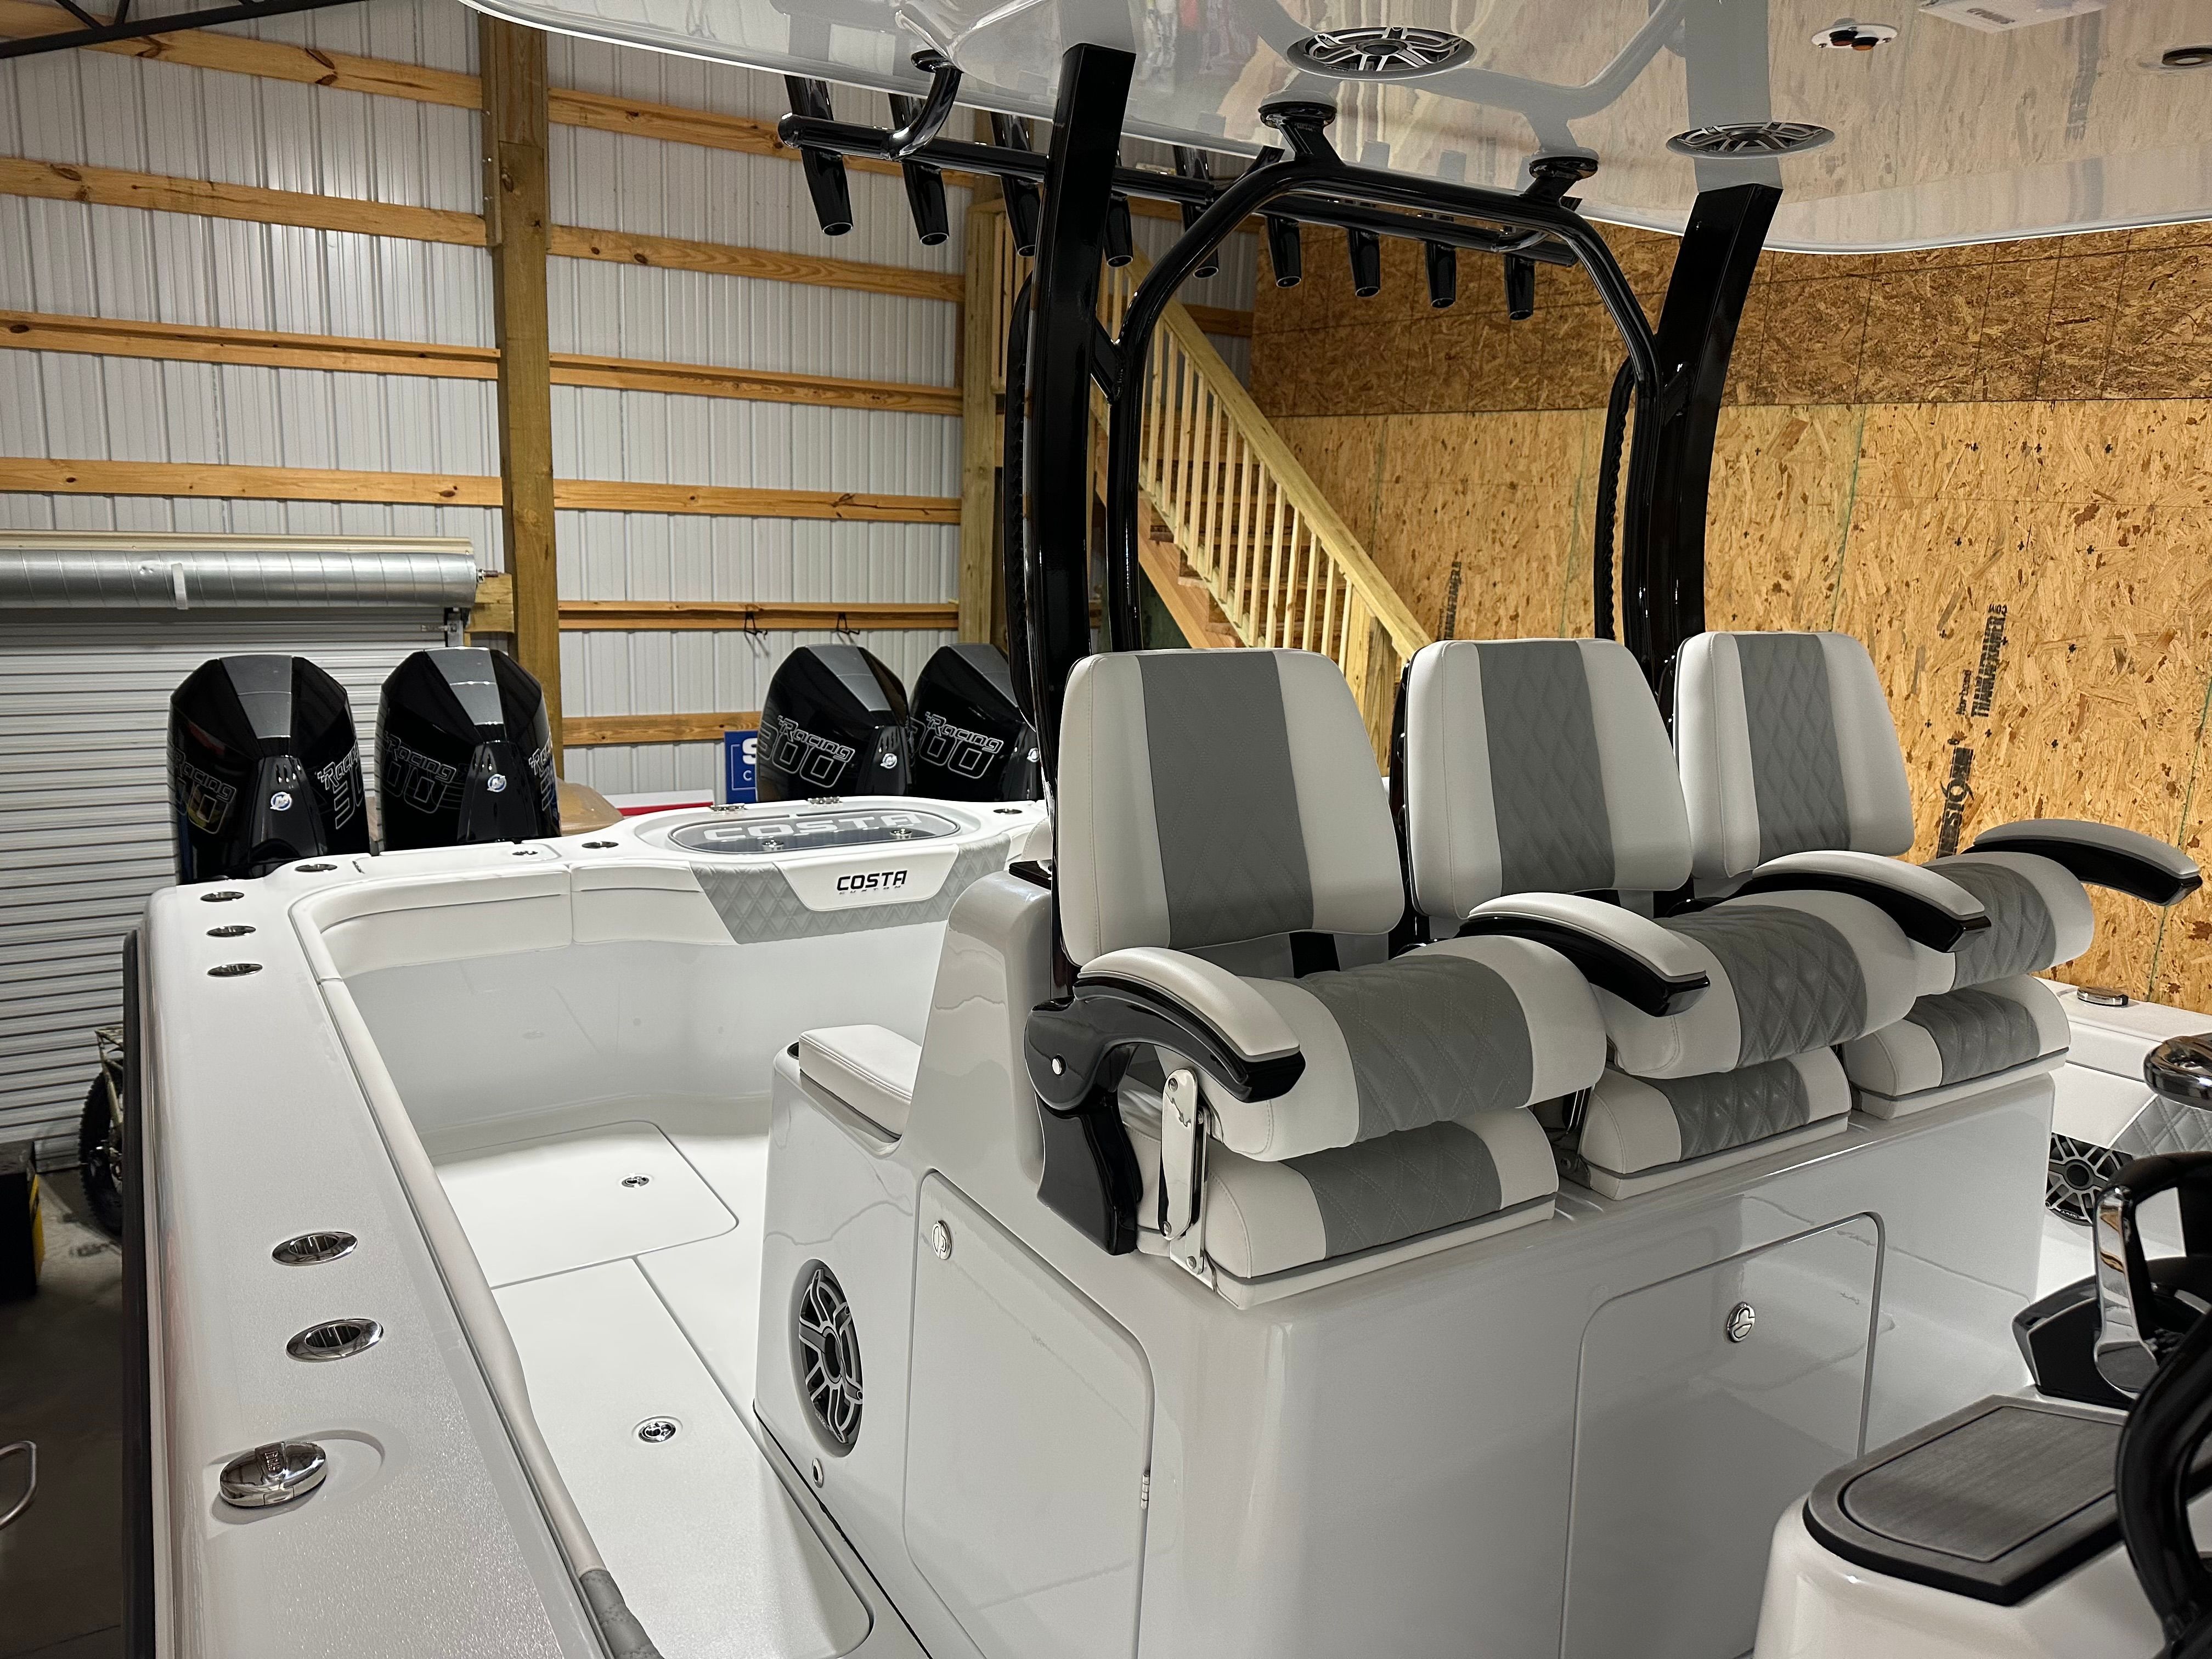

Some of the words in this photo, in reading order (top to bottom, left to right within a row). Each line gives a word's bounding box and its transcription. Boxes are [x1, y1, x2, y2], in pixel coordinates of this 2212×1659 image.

[778, 715, 856, 763] Racing
[926, 712, 1004, 754] Racing
[703, 813, 922, 840] COSTA
[837, 870, 908, 891] COSTA
